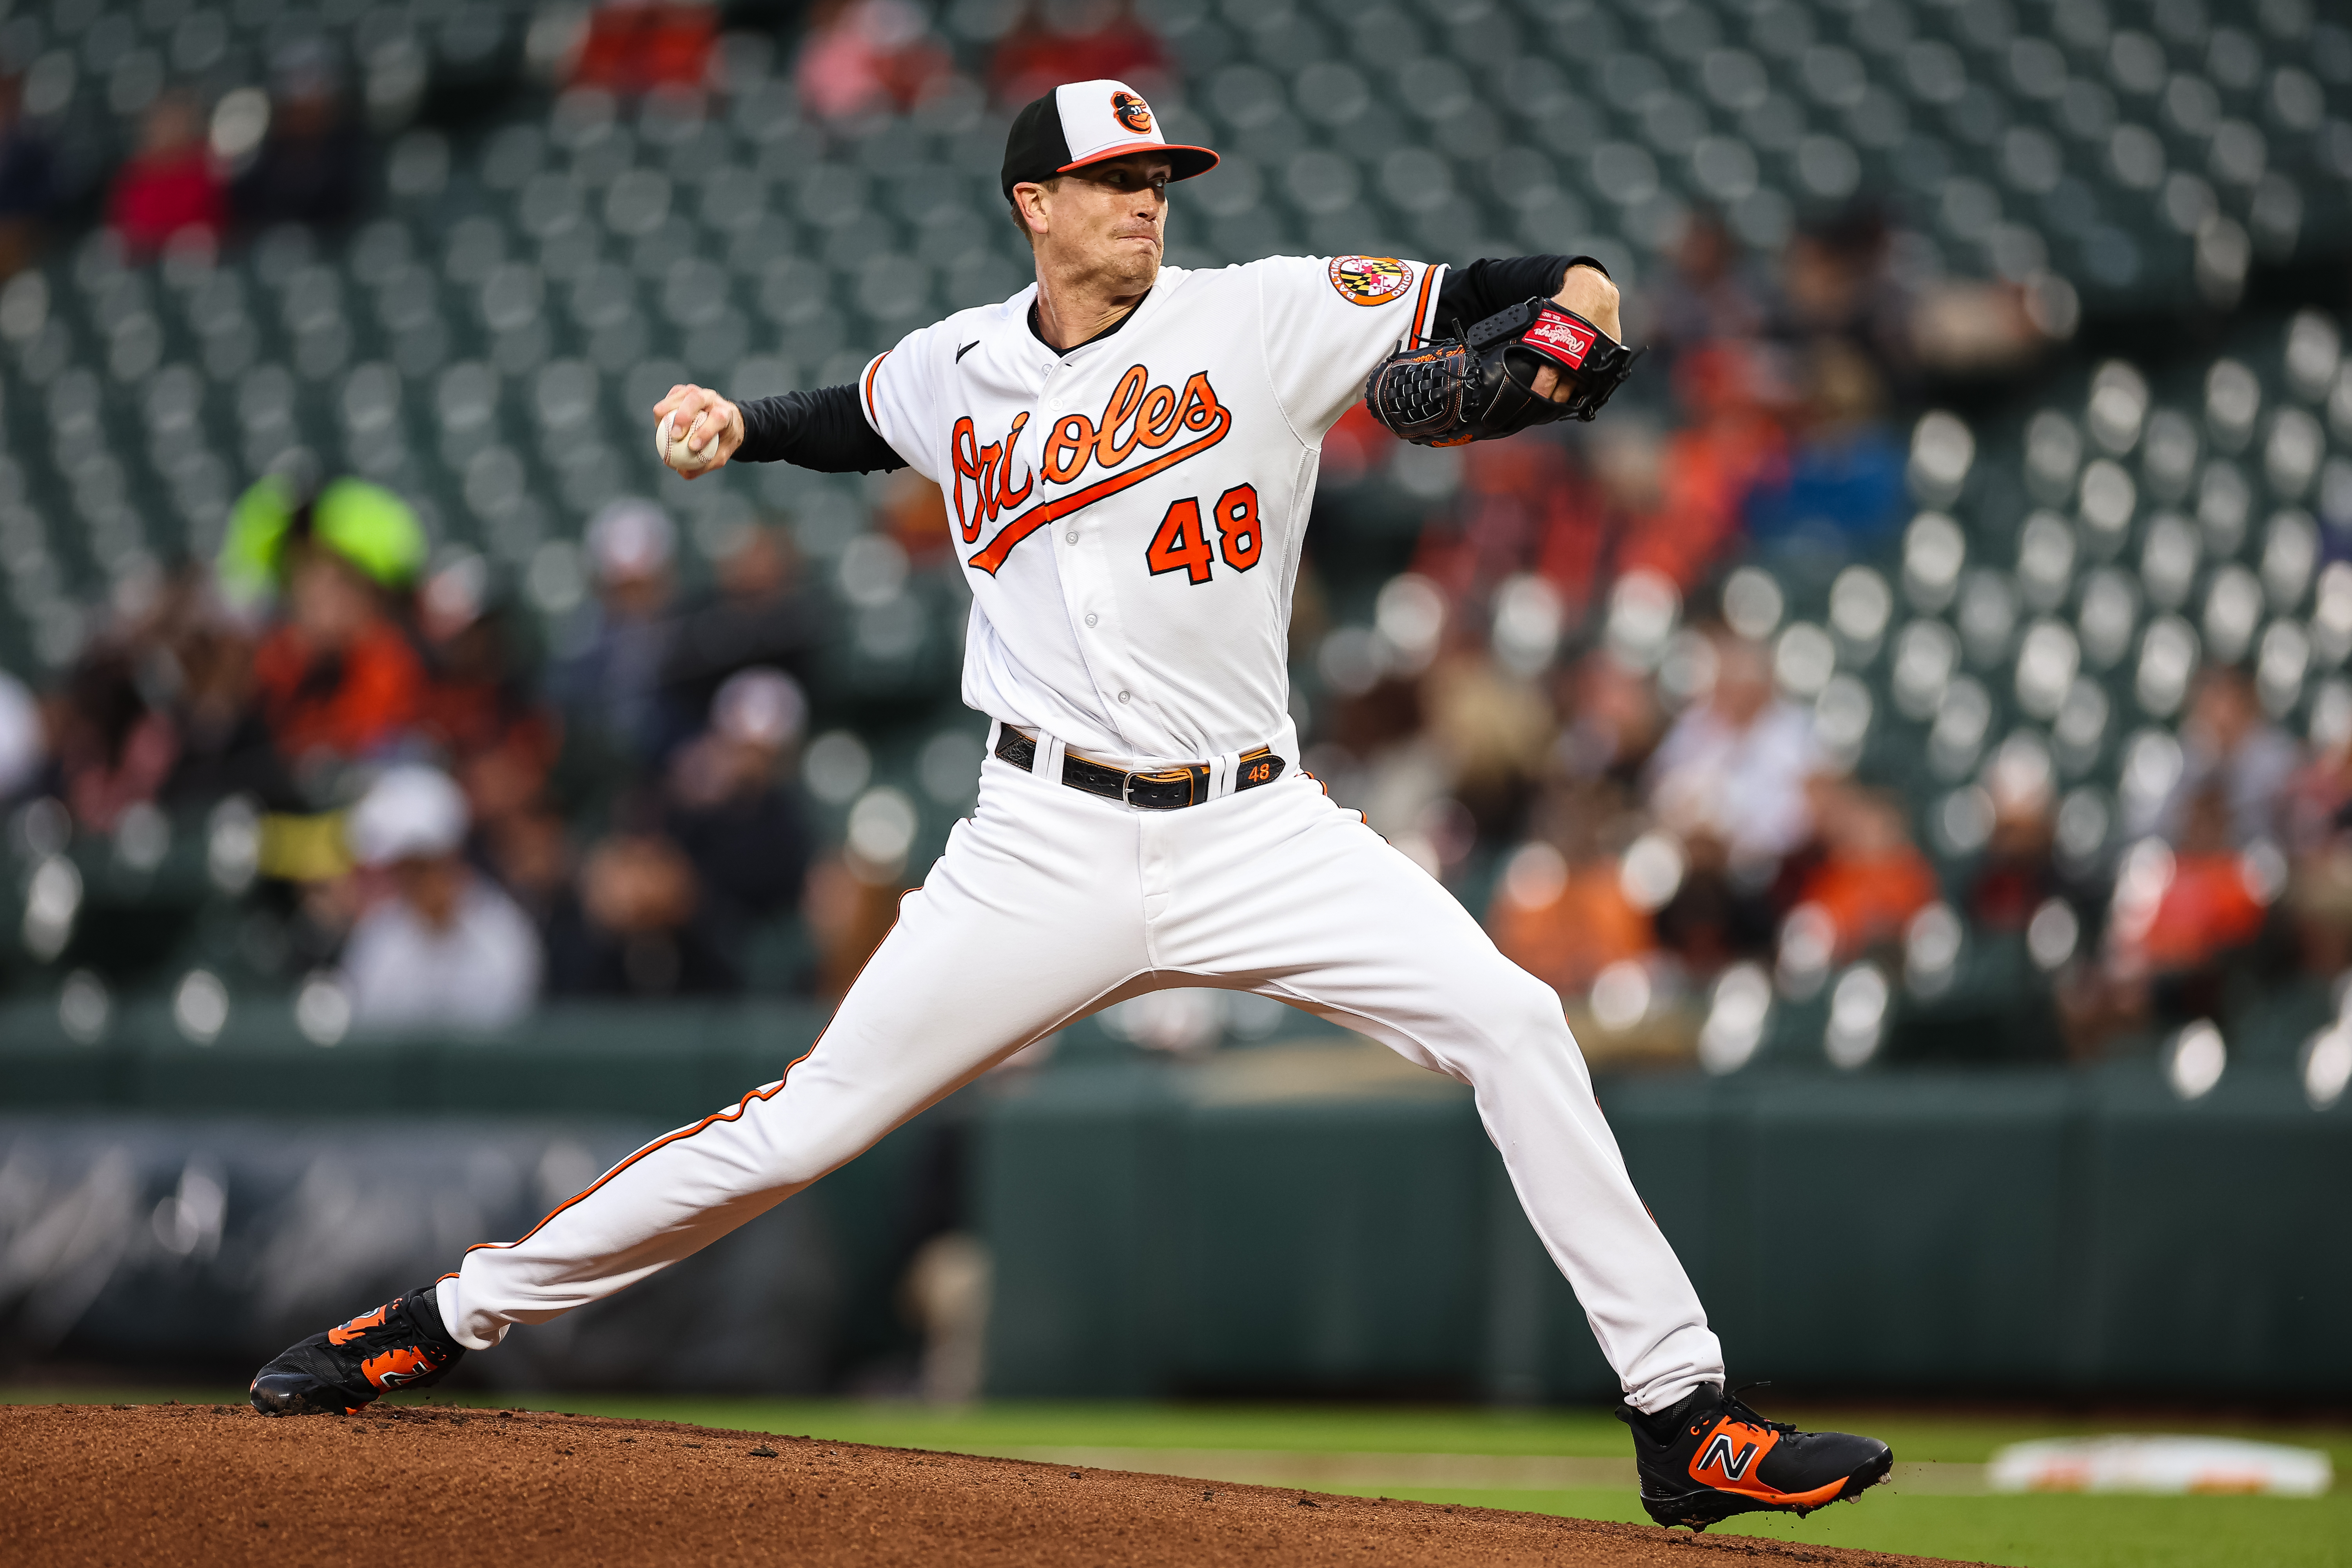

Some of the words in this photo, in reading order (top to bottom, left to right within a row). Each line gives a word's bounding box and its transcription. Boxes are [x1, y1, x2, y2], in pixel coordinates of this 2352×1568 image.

[1330, 255, 1361, 299] BALTIMORE
[1391, 261, 1412, 297] ORIOLES
[1533, 323, 1585, 353] Rawlings
[951, 363, 1232, 578] Orioles
[1145, 482, 1263, 586] 48
[1248, 763, 1270, 782] 48
